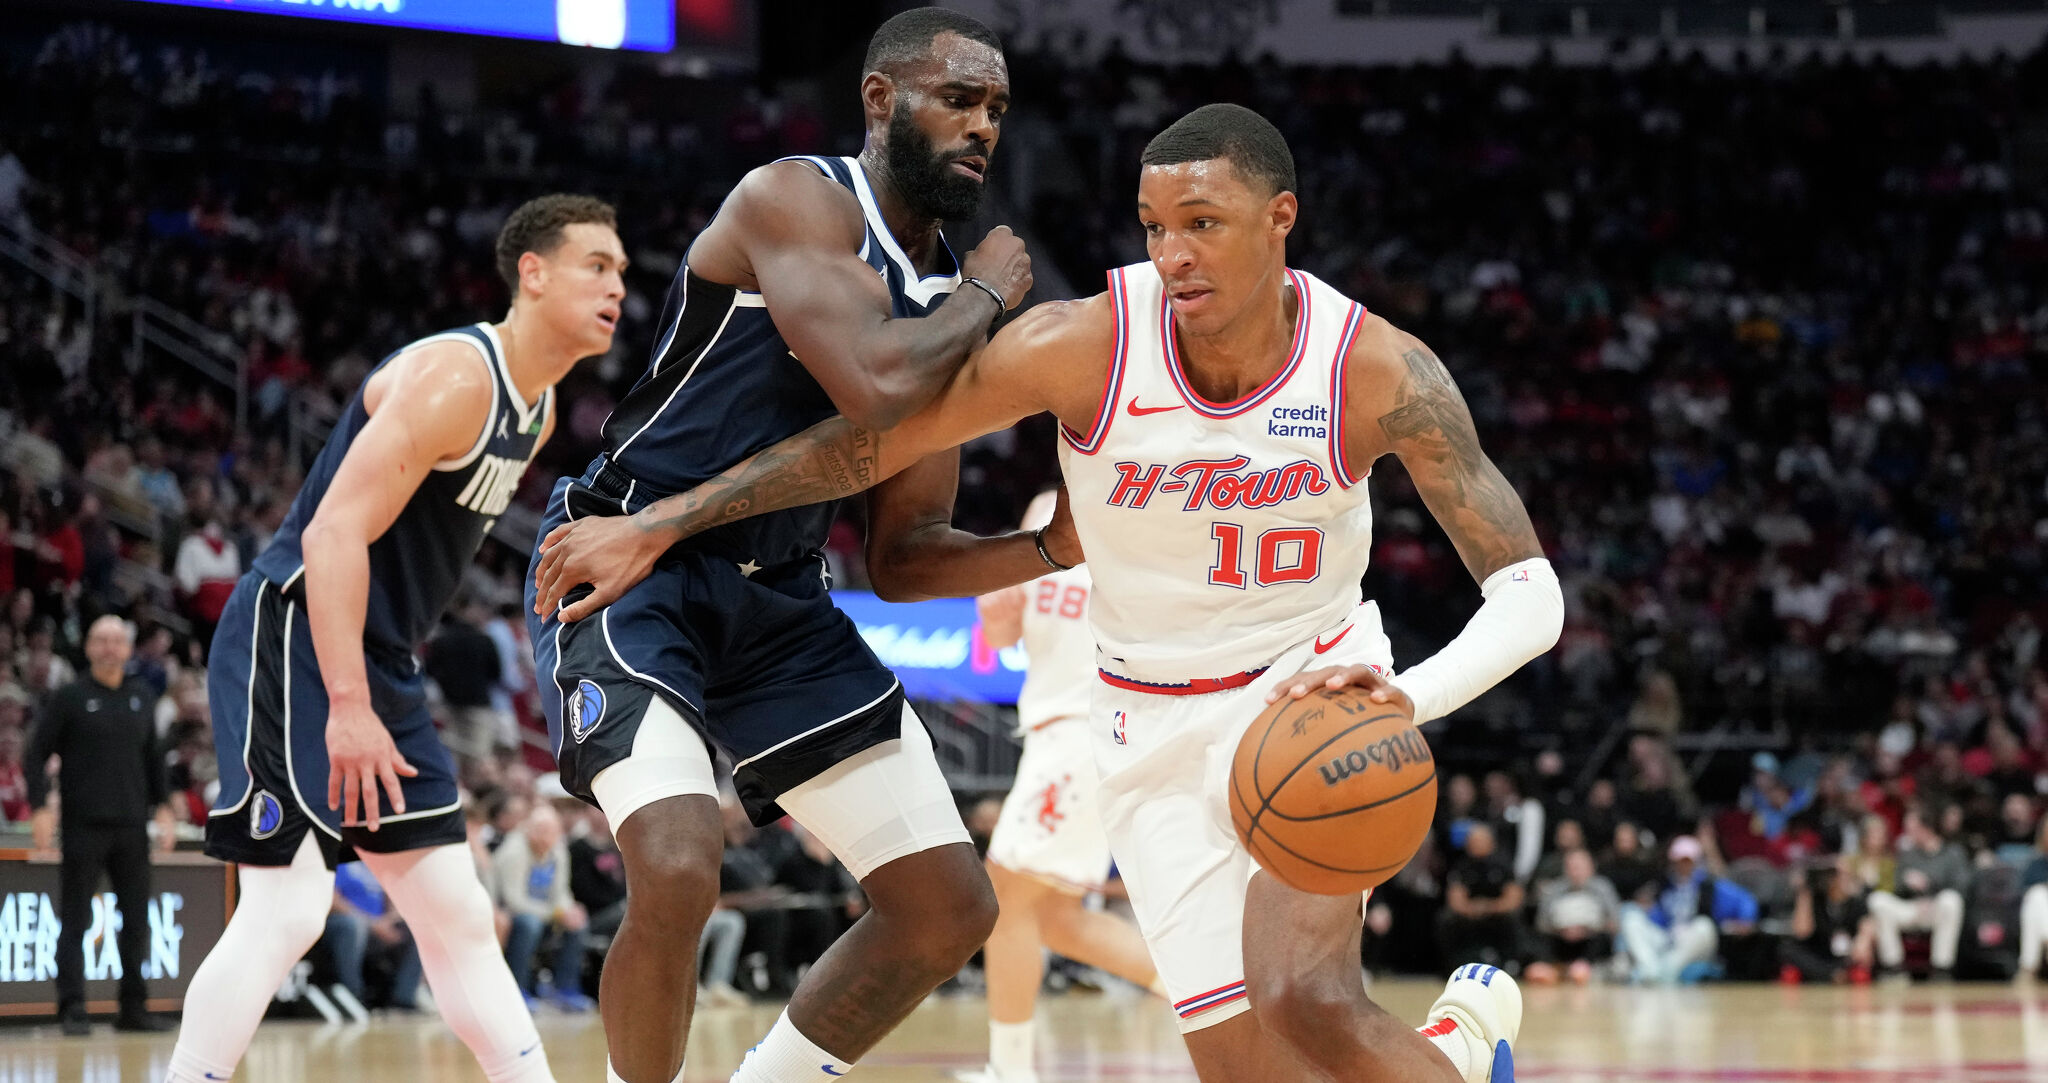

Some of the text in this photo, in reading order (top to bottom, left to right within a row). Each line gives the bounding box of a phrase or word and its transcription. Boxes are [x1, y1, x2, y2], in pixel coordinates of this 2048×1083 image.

[1267, 419, 1327, 439] karma
[1271, 404, 1328, 422] credit
[1106, 454, 1331, 512] H-Town
[1207, 521, 1326, 590] 10
[1036, 580, 1088, 620] 28
[1318, 729, 1431, 786] Wilson
